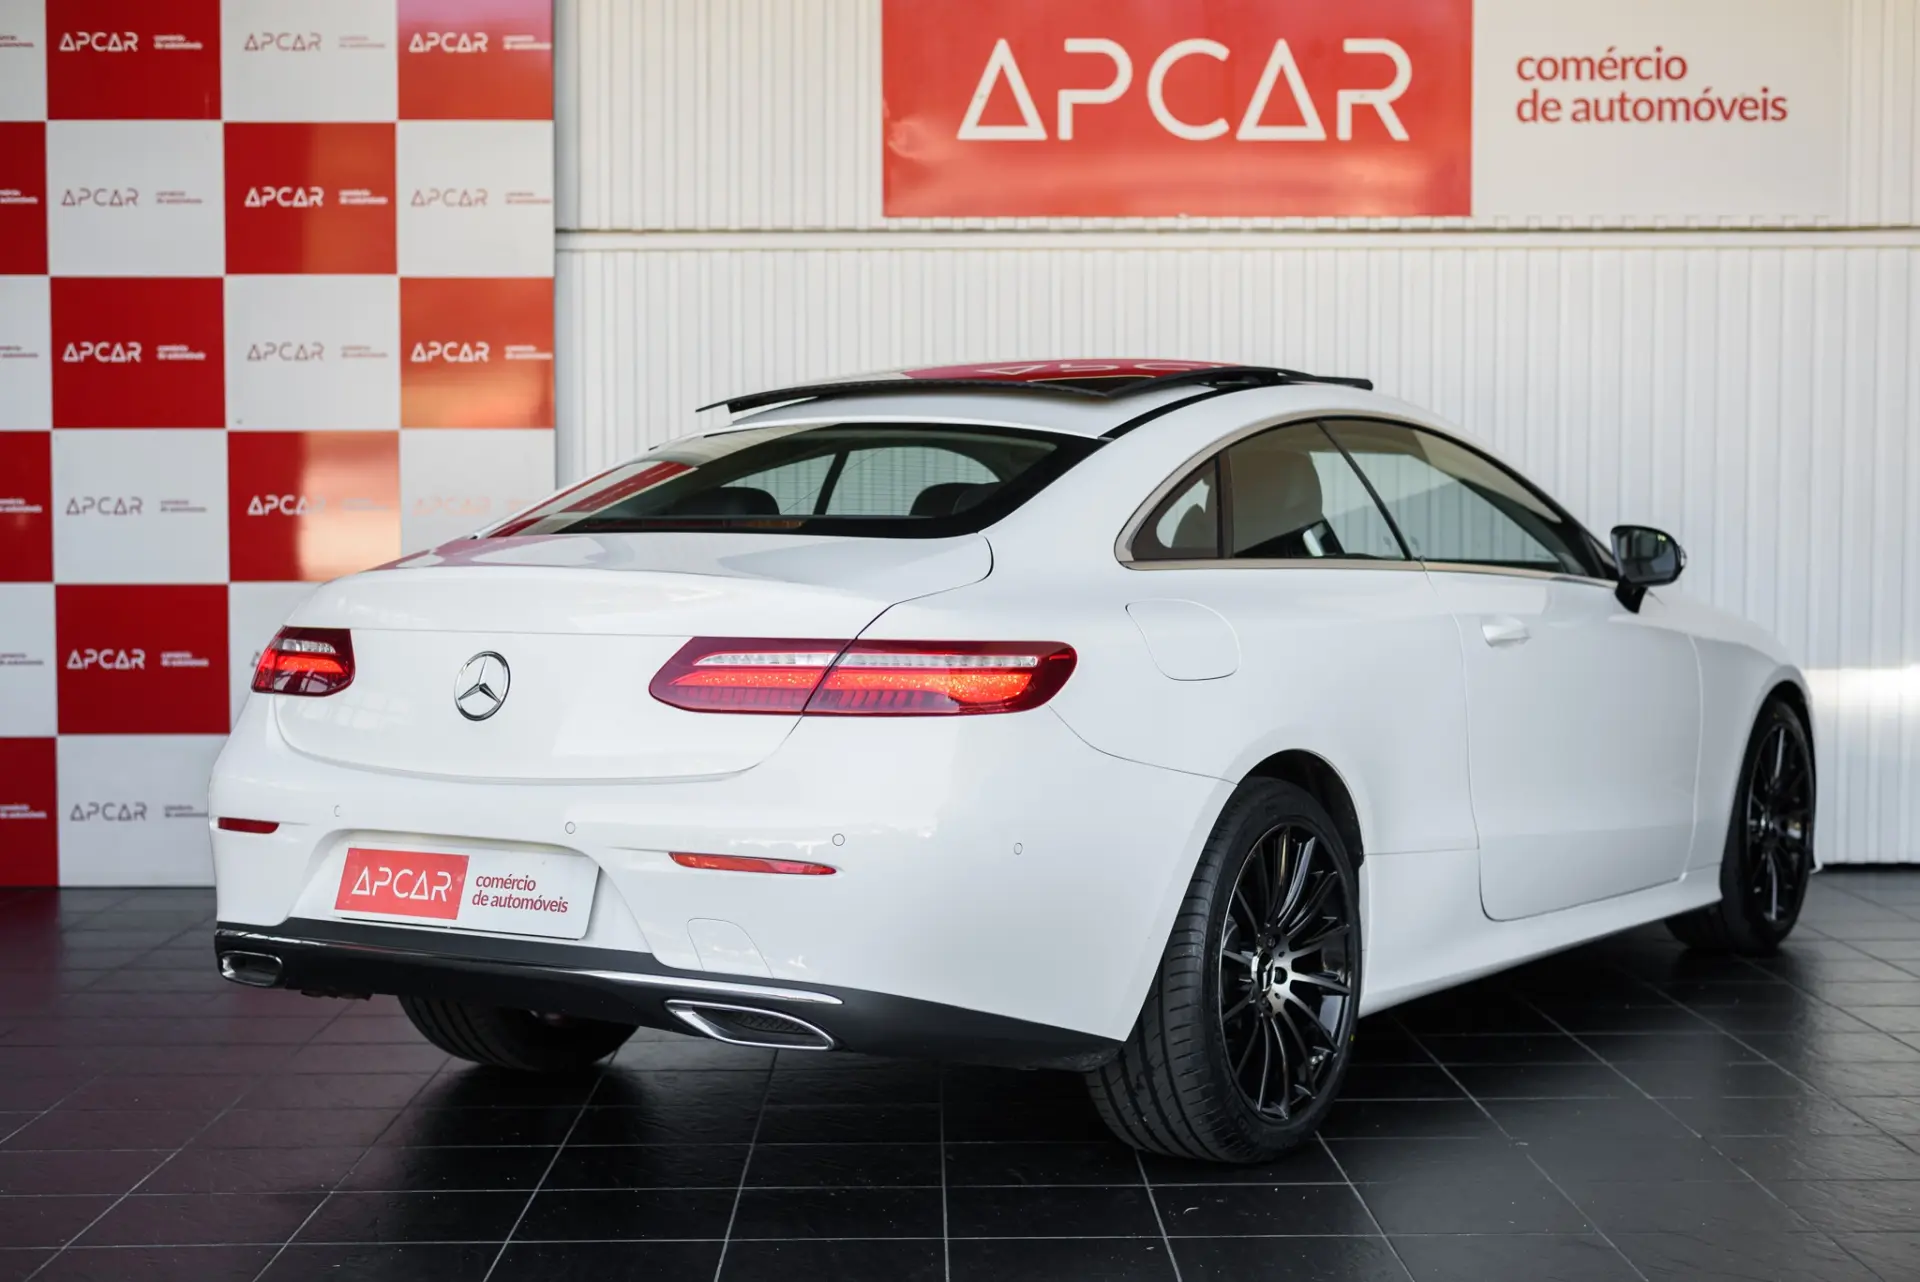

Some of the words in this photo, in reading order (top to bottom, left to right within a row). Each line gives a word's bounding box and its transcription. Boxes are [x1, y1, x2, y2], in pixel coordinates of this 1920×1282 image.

[59, 31, 139, 52] APCAR
[243, 32, 322, 52] APCAR
[409, 31, 489, 53] APCAR
[1516, 46, 1688, 81] comércio
[956, 37, 1413, 142] APCAR
[1516, 88, 1563, 123] de
[1571, 87, 1788, 123] automóveis
[61, 187, 139, 207] APCAR
[244, 186, 325, 208] APCAR
[62, 341, 142, 363] APCAR
[246, 342, 325, 362] APCAR
[410, 341, 490, 363] APCAR
[65, 496, 143, 516] APCAR
[66, 648, 146, 669] APCAR
[70, 802, 147, 822] APCAR
[351, 866, 452, 902] APCAR
[475, 873, 536, 892] comércio
[471, 889, 489, 906] de
[490, 893, 569, 913] automóveis
